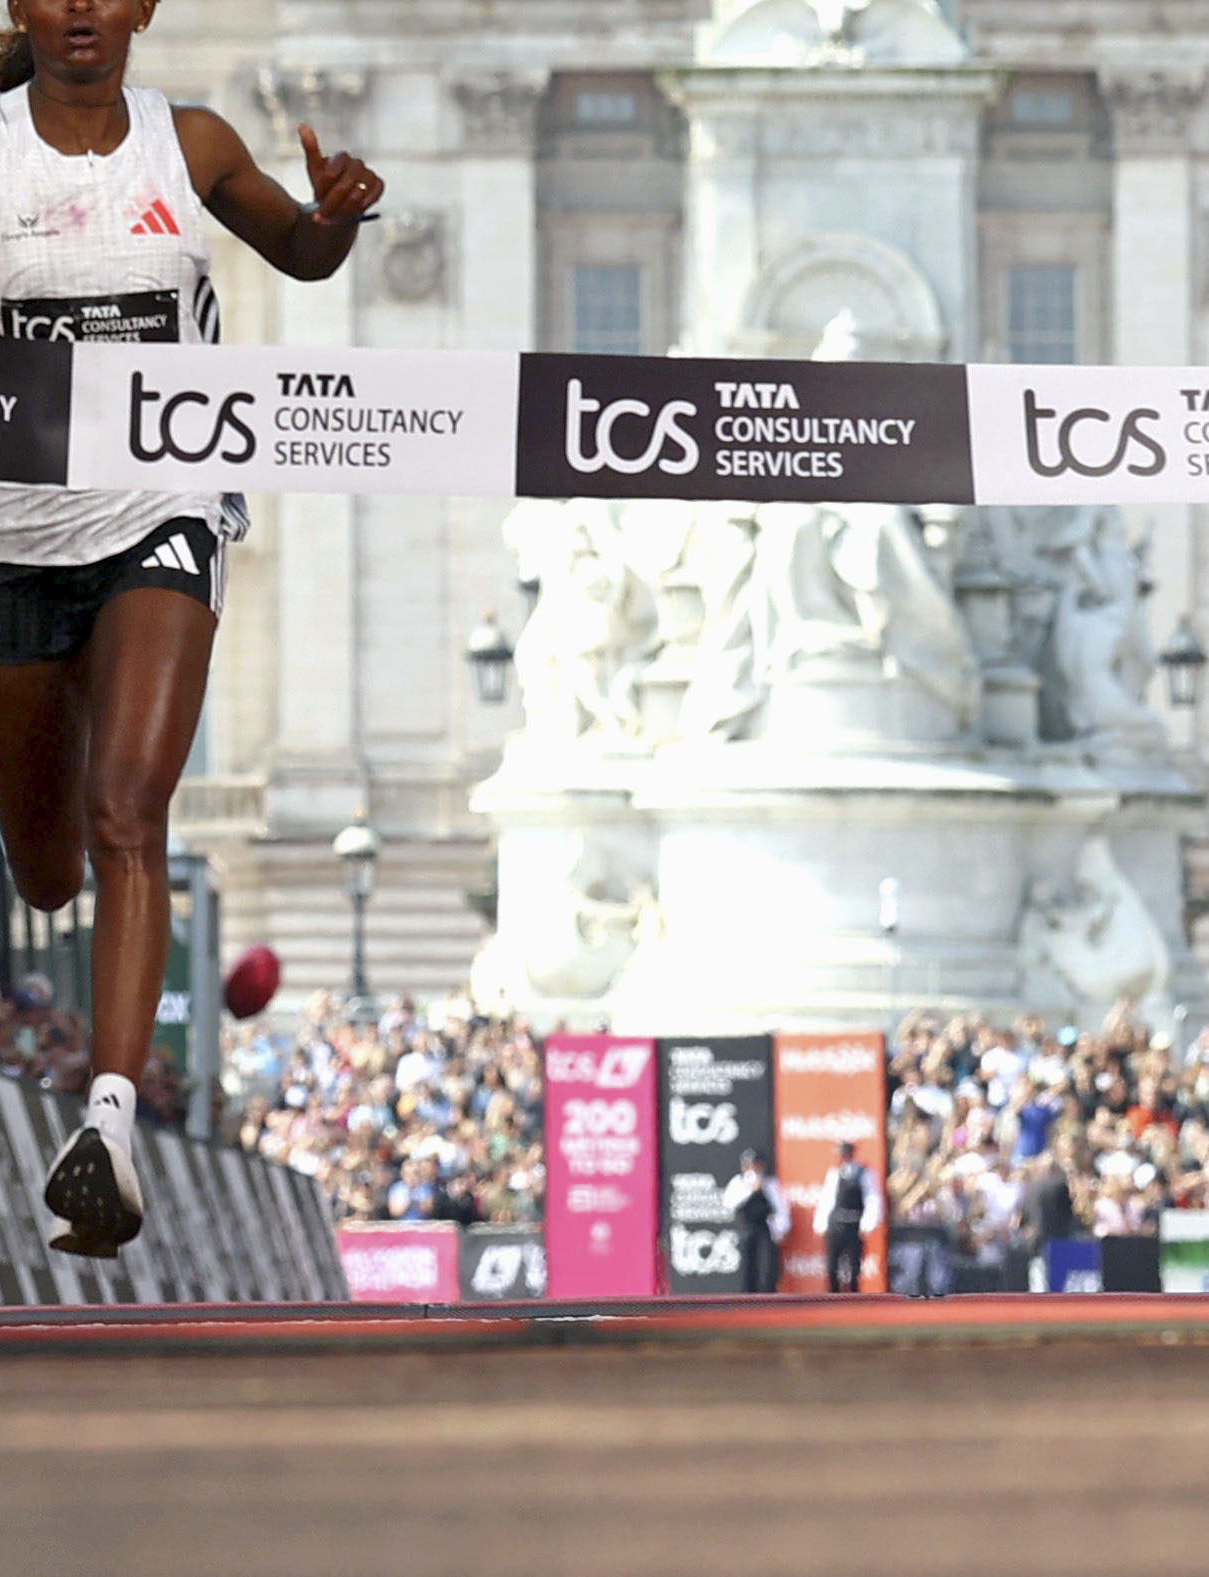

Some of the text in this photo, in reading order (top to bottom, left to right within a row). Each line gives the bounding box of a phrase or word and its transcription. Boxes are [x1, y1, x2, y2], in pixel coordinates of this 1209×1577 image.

[81, 304, 122, 320] TATA
[81, 314, 168, 334] CONSULTANCY
[276, 373, 355, 398] TATA
[714, 382, 800, 410] TATA
[129, 370, 257, 465] tcs
[274, 406, 464, 435] CONSULTANCY
[566, 378, 700, 475] tcs
[715, 416, 916, 445] CONSULTANCY
[1023, 388, 1167, 478] tcs
[274, 440, 392, 467] SERVICES
[715, 450, 845, 478] SERVICES
